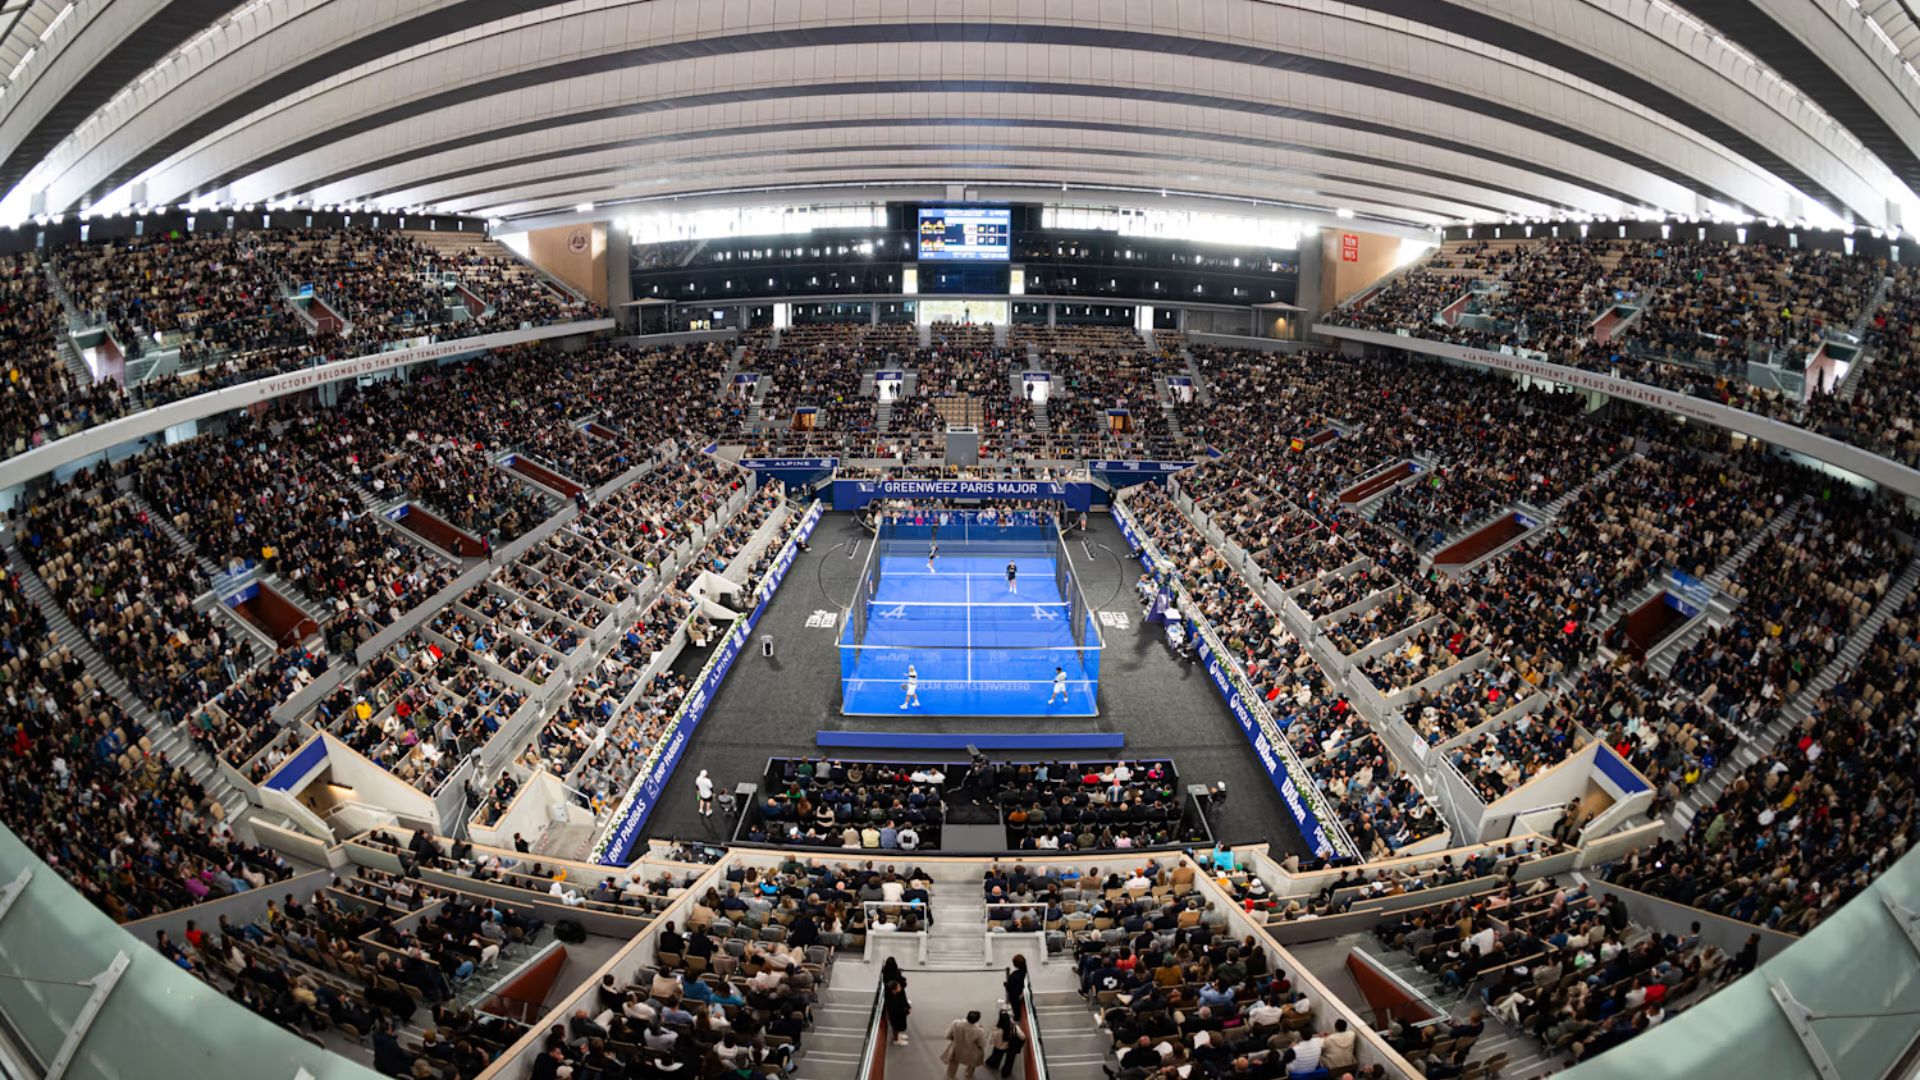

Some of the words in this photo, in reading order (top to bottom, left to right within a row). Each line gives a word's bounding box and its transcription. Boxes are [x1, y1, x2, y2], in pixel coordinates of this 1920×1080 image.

[269, 376, 313, 391] VICTORY
[317, 365, 358, 380] BELONGS
[361, 362, 372, 370] TO
[375, 358, 391, 368] THE
[394, 354, 414, 364] MOST
[417, 345, 457, 359] TENACIOUS
[1480, 355, 1513, 368] VICTOIRE
[1515, 361, 1565, 380] APPARTIENT
[1582, 377, 1605, 390] PLUS
[884, 482, 958, 493] GREENWEEZ
[961, 482, 995, 493] PARIS
[997, 482, 1038, 494] MAJOR
[709, 649, 733, 687] ALPINE
[1215, 669, 1230, 693] VEOLIA
[1236, 702, 1252, 731] VEOLIA
[653, 762, 666, 784] BNP
[664, 730, 685, 767] PARIBAS
[1255, 731, 1277, 775] Wilson
[1281, 776, 1307, 825] Wilson
[608, 837, 623, 864] BNP
[620, 798, 647, 842] PARIBAS
